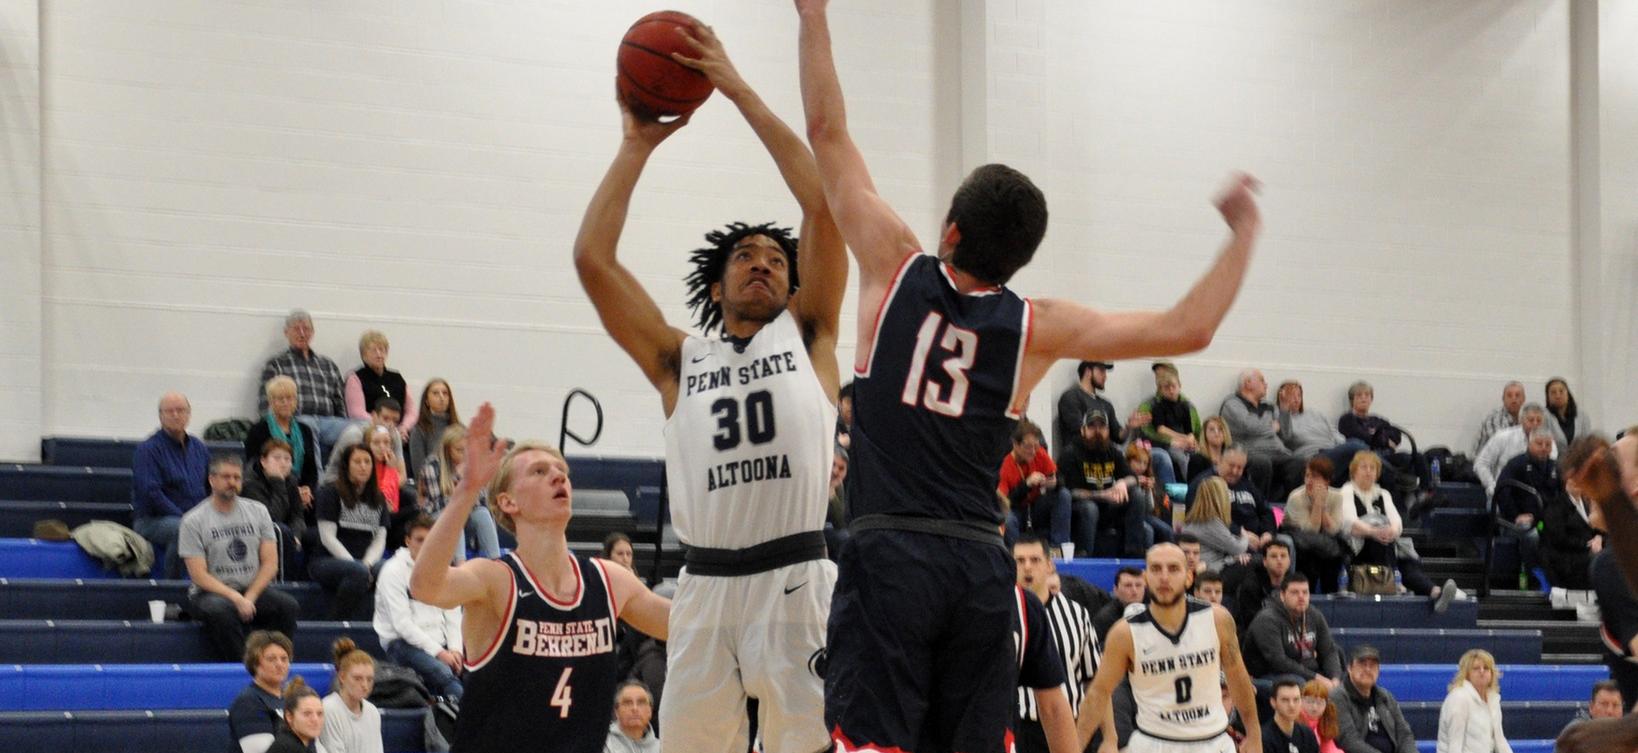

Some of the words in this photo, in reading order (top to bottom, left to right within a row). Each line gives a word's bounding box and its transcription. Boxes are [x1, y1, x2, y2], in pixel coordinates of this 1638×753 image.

[686, 366, 731, 396] PENN
[738, 351, 797, 386] STATE
[900, 309, 979, 419] 13
[711, 389, 776, 452] 30
[707, 454, 792, 492] ALTOONA
[512, 617, 614, 658] BEHREND
[539, 621, 563, 635] PENN
[565, 620, 595, 635] STATE
[1141, 657, 1176, 675] PENN
[1179, 648, 1216, 670] STATE
[549, 666, 574, 719] 4
[1174, 675, 1193, 704] 0
